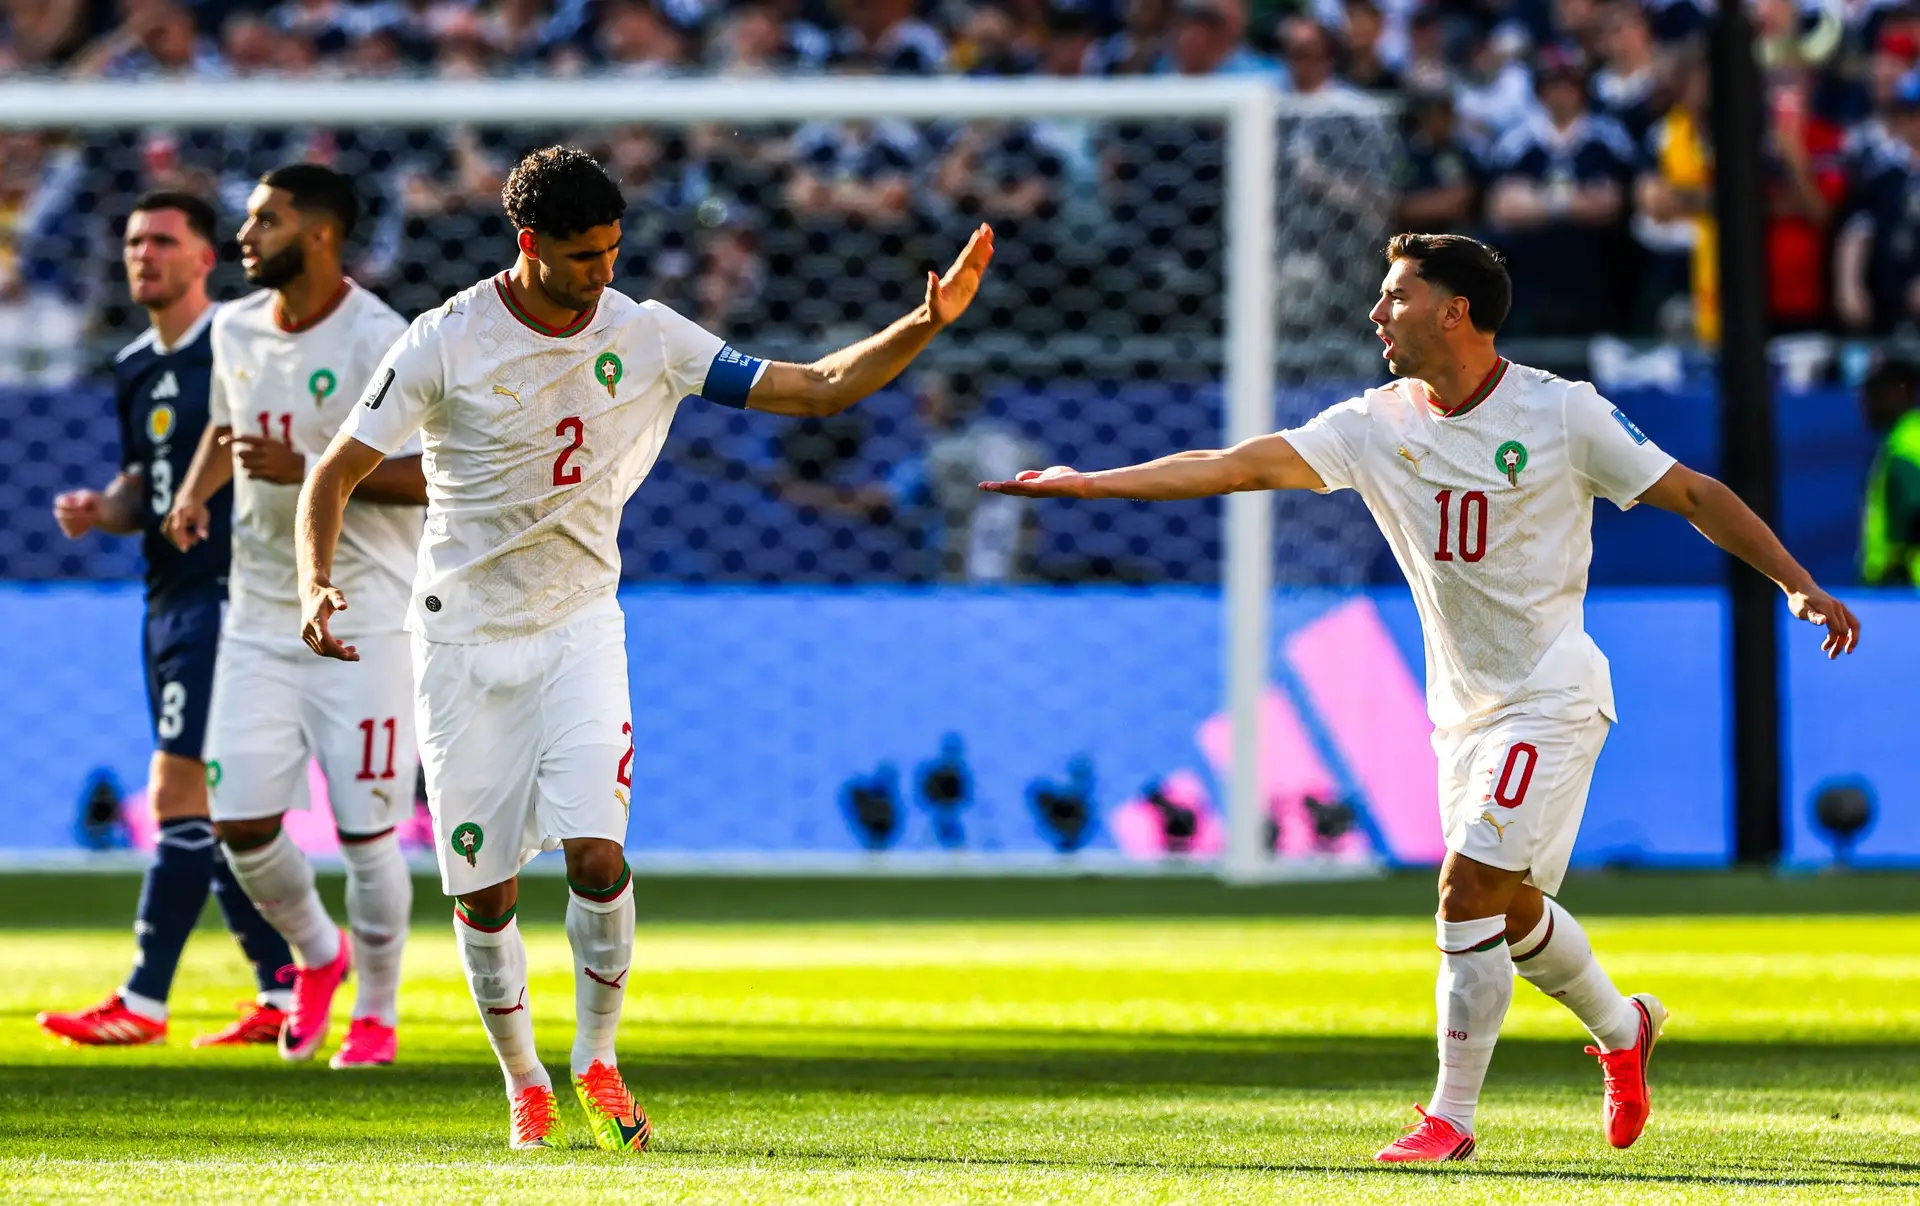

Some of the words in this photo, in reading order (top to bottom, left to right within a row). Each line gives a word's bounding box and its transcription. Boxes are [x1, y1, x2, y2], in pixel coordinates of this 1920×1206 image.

[553, 416, 585, 486] 2
[151, 459, 173, 516] 3
[1434, 489, 1488, 563] 10
[158, 681, 187, 739] 3
[356, 716, 398, 781] 11
